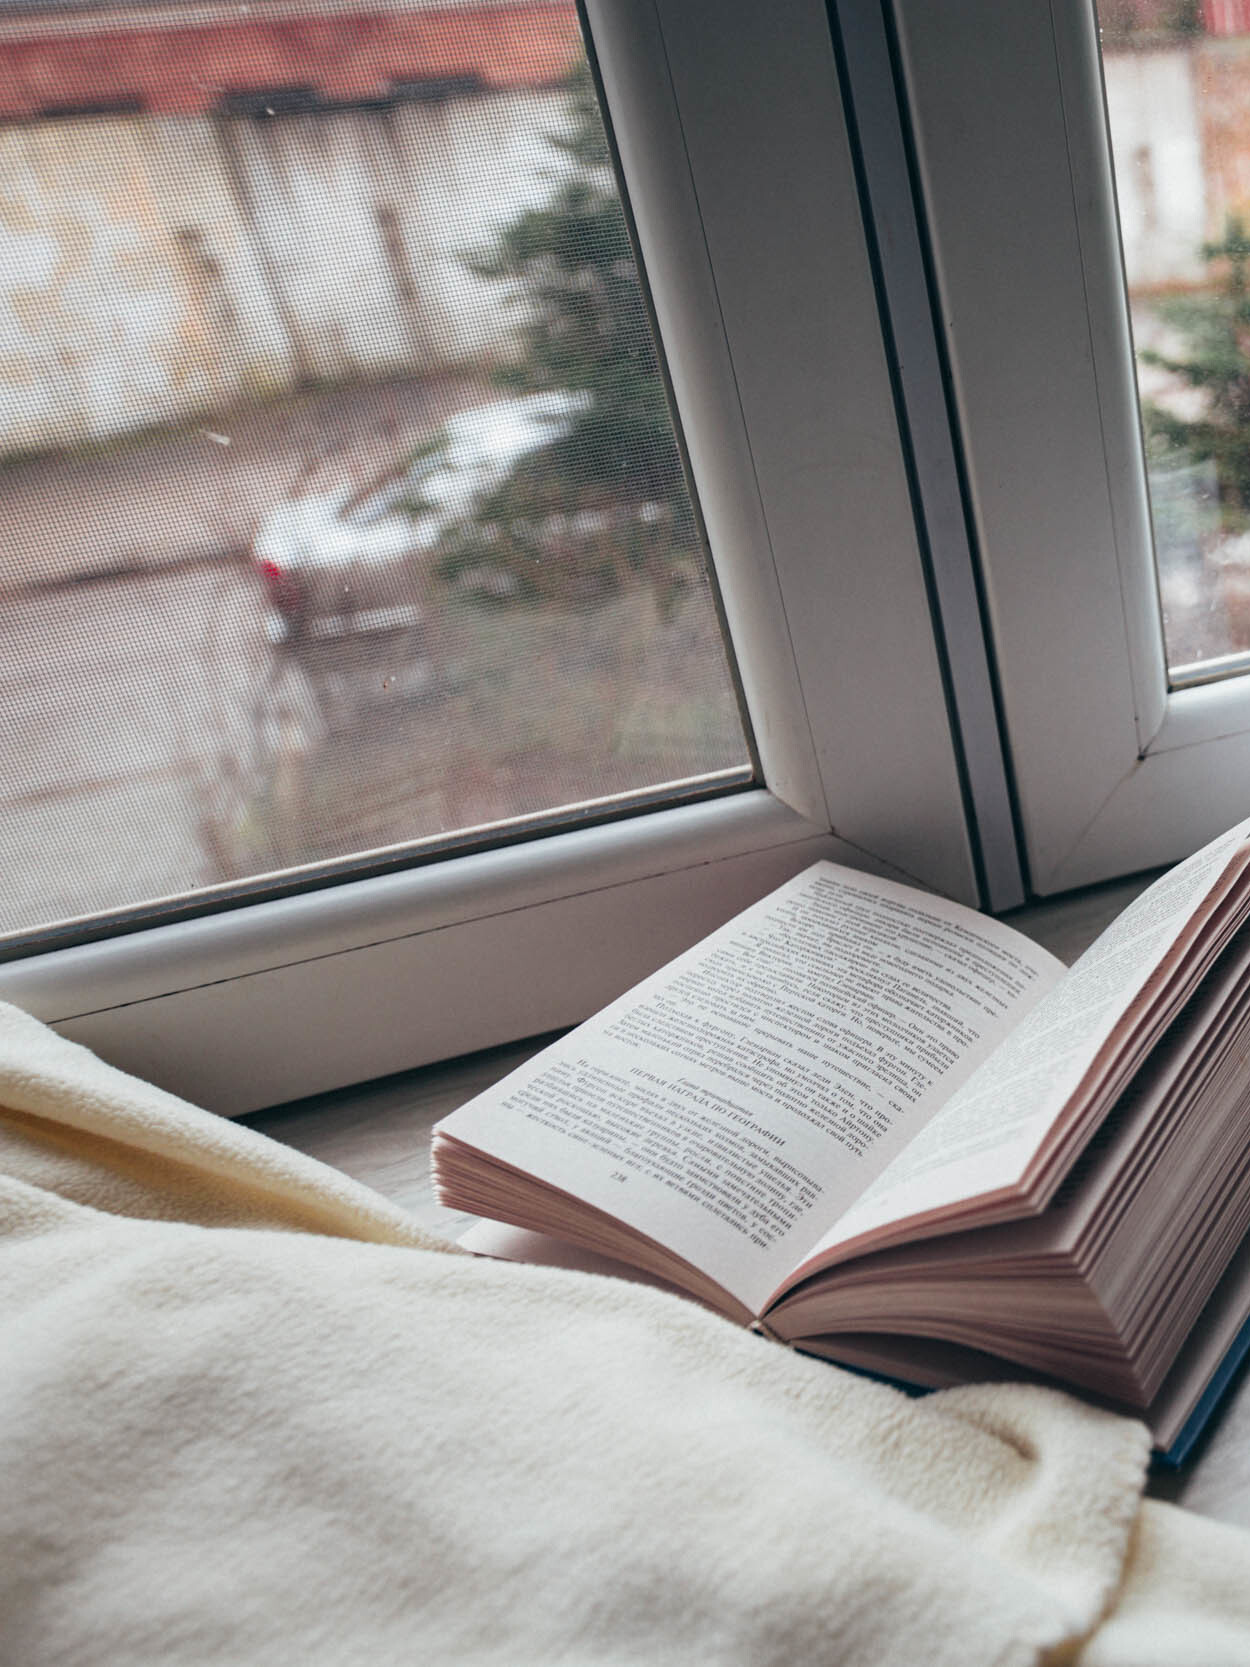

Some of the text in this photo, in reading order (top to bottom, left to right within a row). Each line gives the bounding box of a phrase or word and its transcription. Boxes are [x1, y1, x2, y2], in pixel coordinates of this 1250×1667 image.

[630, 1067, 786, 1145] ПЕРВАЯ НАГРАДА ПО ГЕОГРАФИИ
